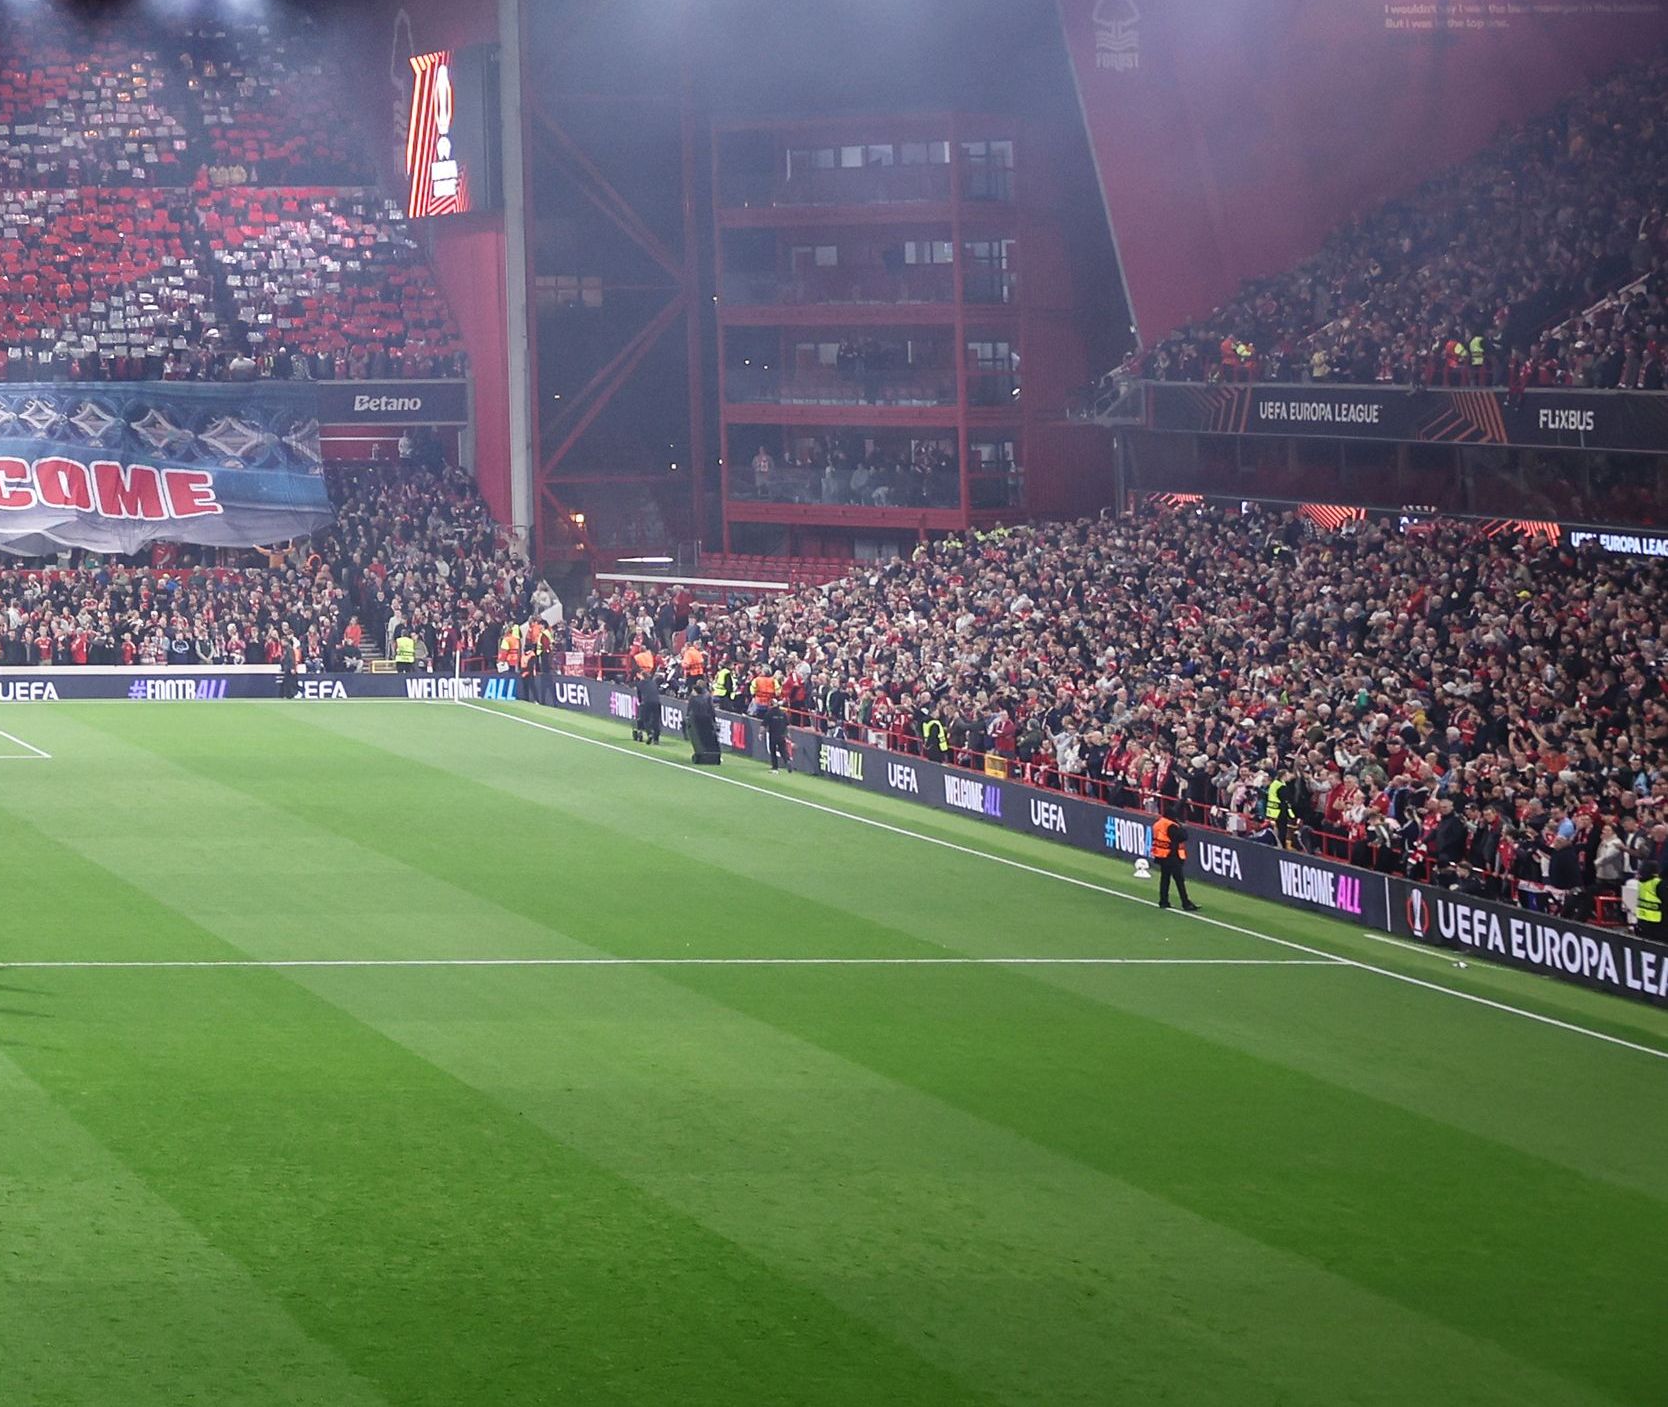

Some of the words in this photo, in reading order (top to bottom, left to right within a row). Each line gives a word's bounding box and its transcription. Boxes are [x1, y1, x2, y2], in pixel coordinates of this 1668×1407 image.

[354, 395, 422, 412] Betano
[1259, 401, 1287, 421] UEFA
[1289, 402, 1332, 422] EUROPA
[1334, 404, 1379, 423] LEAGUE
[1600, 534, 1642, 554] EUROPA
[128, 679, 227, 700] #FOOTBALL
[293, 680, 348, 699] EFA
[406, 677, 481, 699] WELCOME
[484, 678, 517, 700] ALL
[555, 682, 591, 707] UEFA
[819, 743, 863, 781] #FOOTBALL
[887, 762, 918, 794] UEFA
[944, 774, 984, 813] WELCOME
[983, 785, 1002, 818] ALL
[1030, 799, 1067, 834] UEFA
[1104, 815, 1153, 858] #FOOTBA
[1199, 841, 1242, 881] UEFA
[1279, 859, 1336, 908] WELCOME
[1336, 875, 1362, 914] ALL
[1437, 899, 1506, 954] UEFA
[1509, 918, 1619, 985] EUROPA
